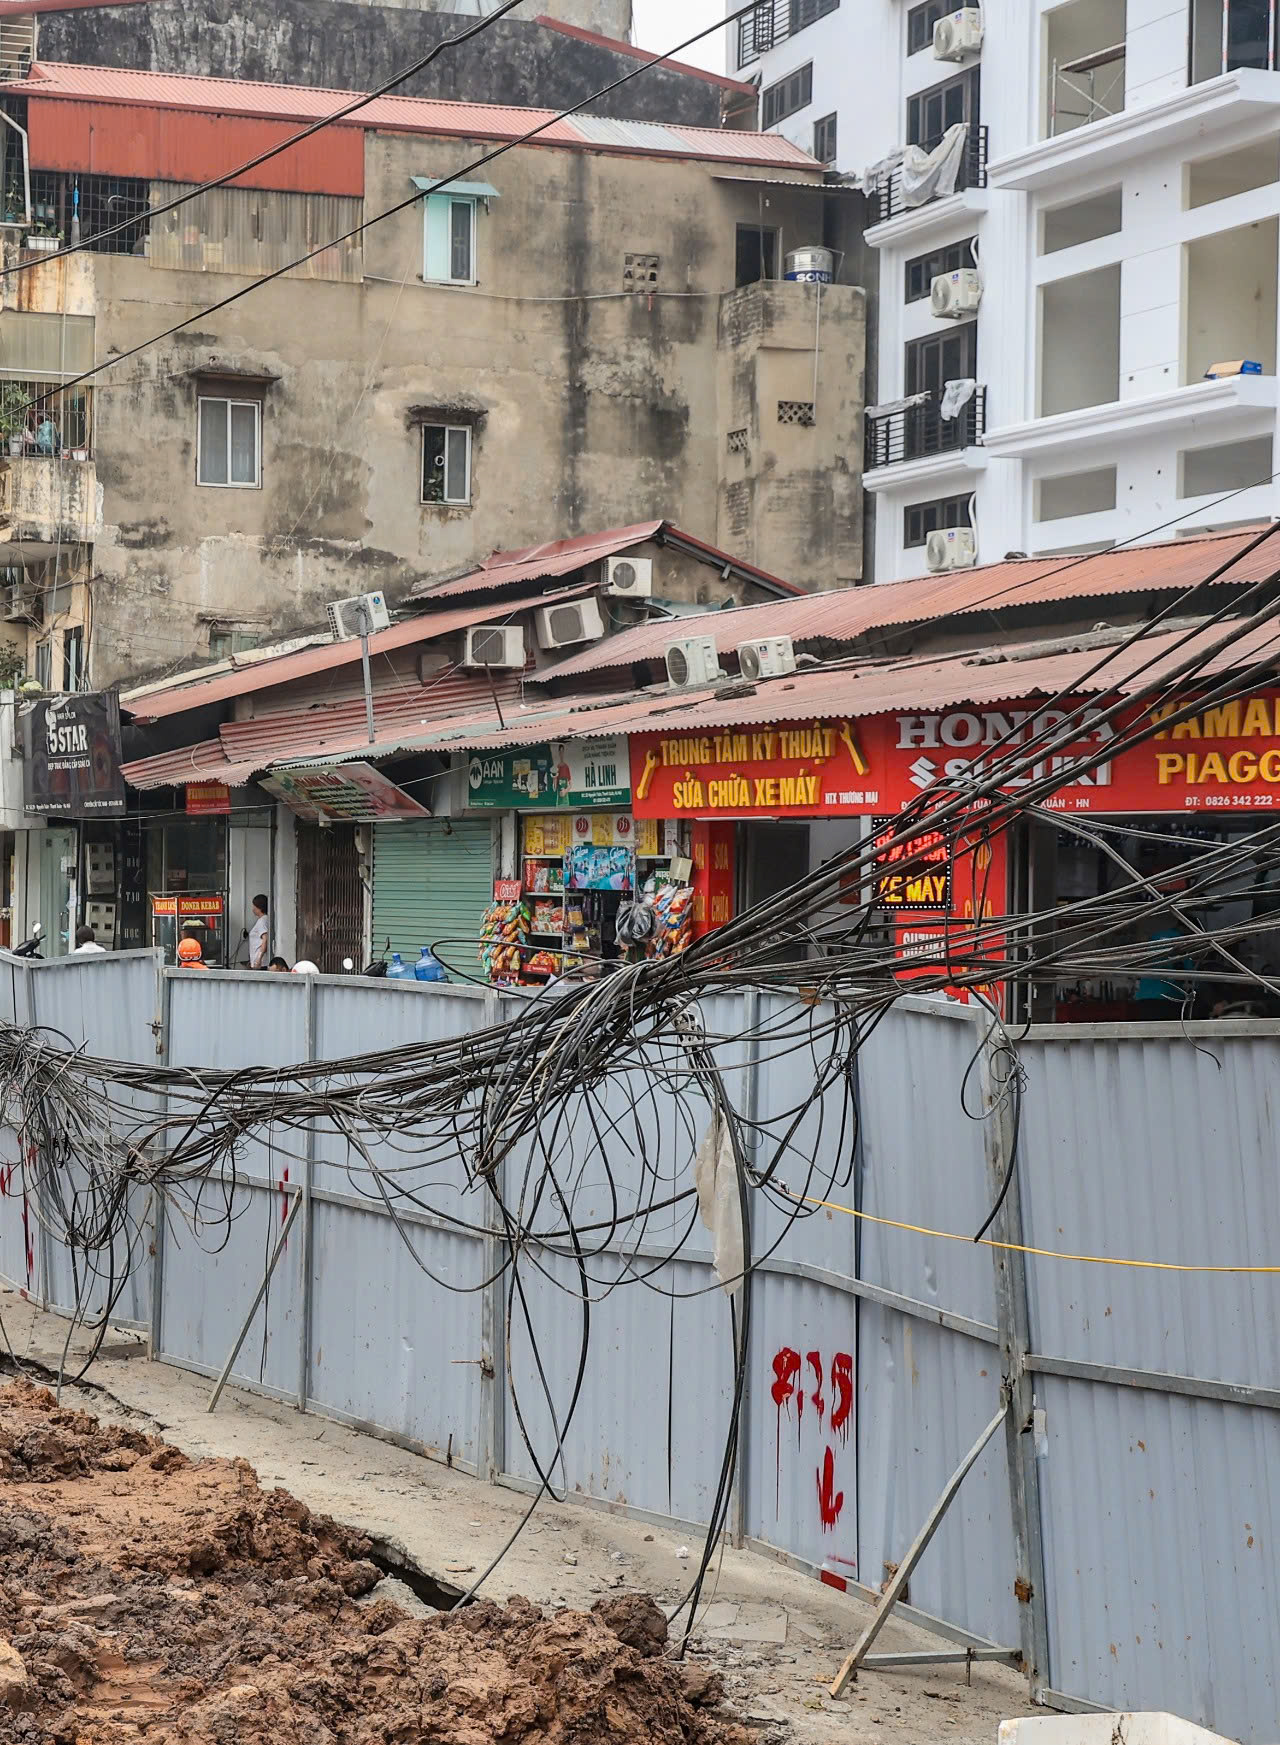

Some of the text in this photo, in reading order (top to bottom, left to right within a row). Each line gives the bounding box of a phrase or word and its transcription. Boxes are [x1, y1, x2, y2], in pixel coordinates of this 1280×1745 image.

[1145, 698, 1280, 739] YAMA
[660, 737, 712, 767] TRUNG
[714, 729, 748, 764] TÂM
[779, 721, 833, 765] THUẬT
[585, 761, 617, 788] HÀ LINH
[673, 768, 817, 808] SỬA CHỮA XE MÁY
[1076, 798, 1090, 808] HN
[1205, 796, 1230, 806] 0826
[1232, 796, 1252, 806] 342
[1254, 795, 1273, 805] 222
[181, 900, 220, 910] DONER KEBAB
